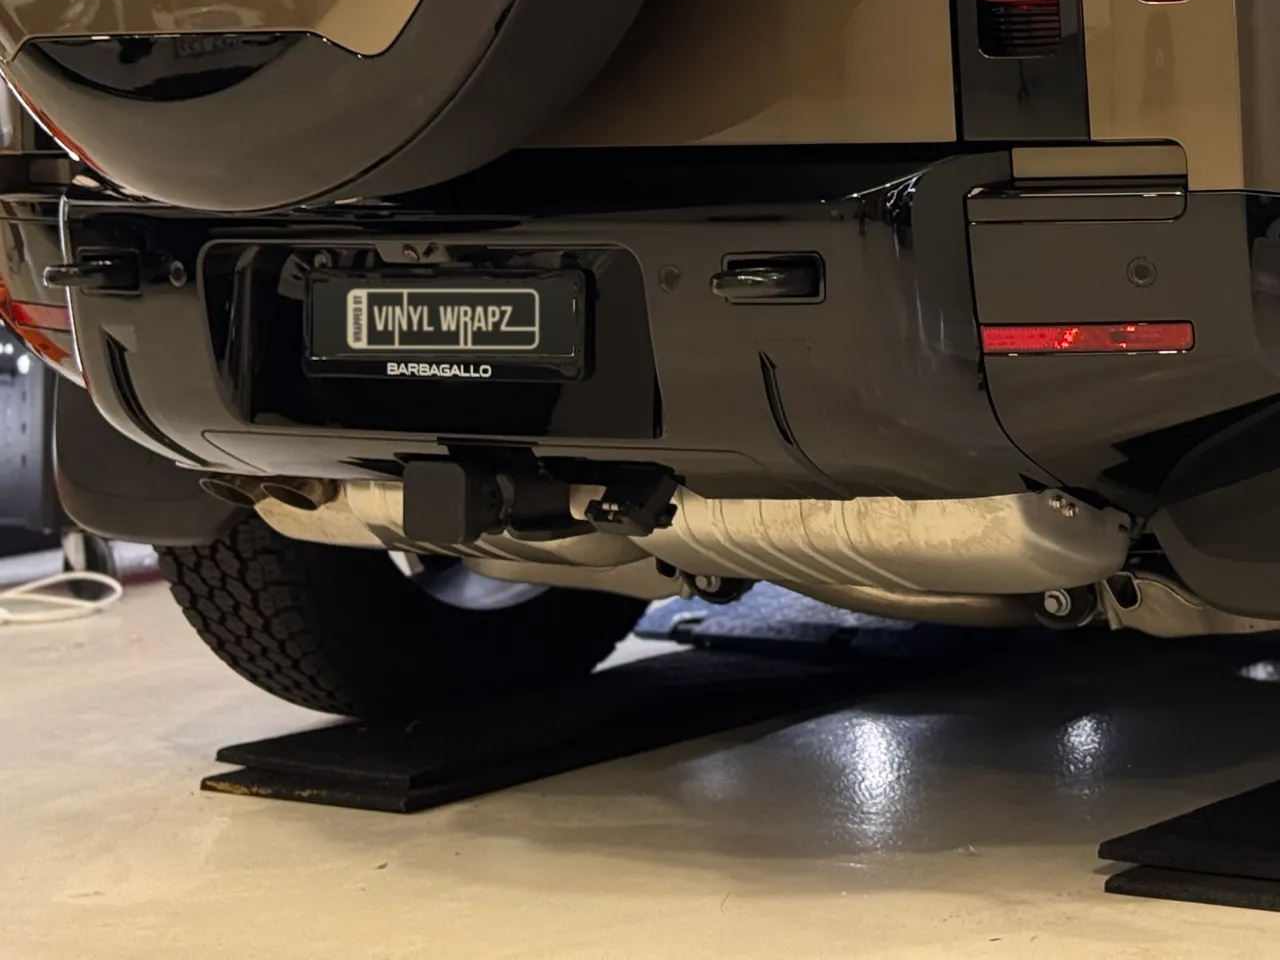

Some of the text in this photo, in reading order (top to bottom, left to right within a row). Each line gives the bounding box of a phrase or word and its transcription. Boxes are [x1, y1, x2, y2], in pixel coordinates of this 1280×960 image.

[373, 304, 514, 333] VINYL WRAPZ
[386, 361, 492, 378] BARBAGALLO
